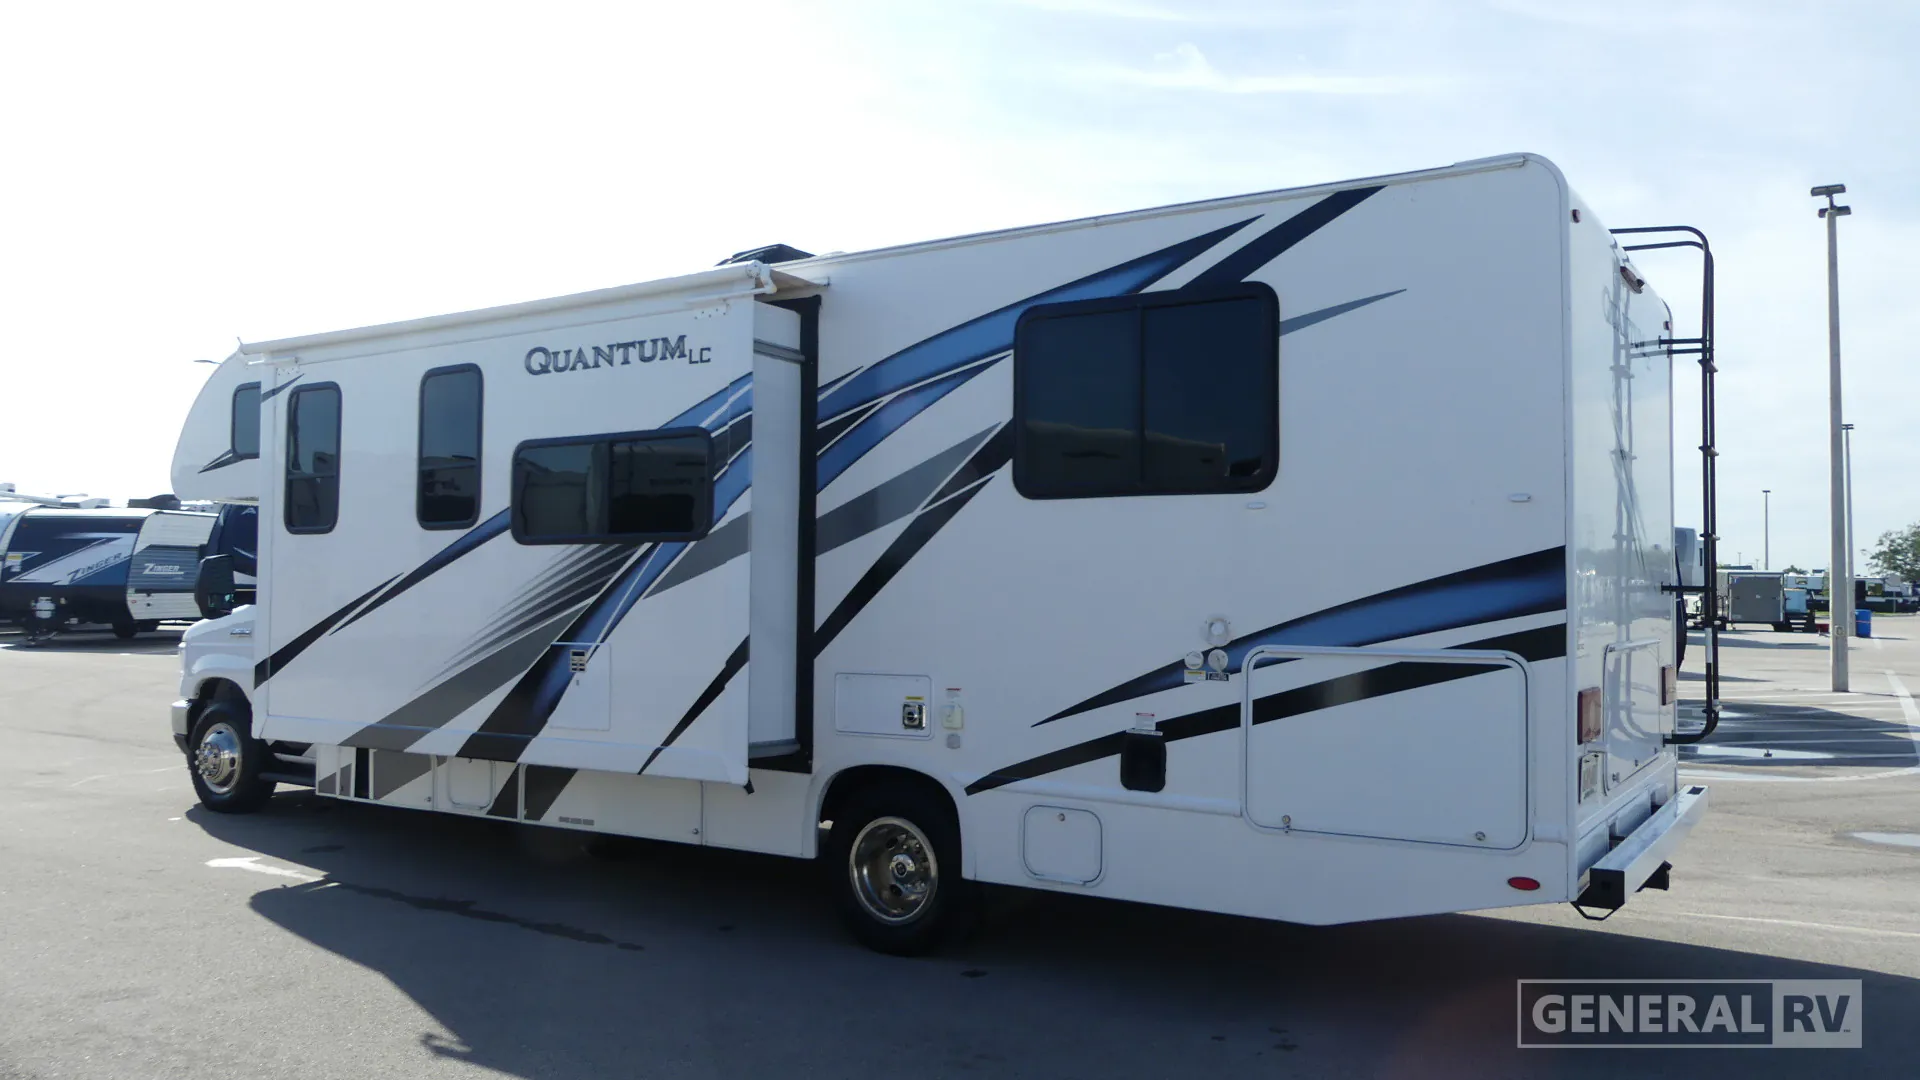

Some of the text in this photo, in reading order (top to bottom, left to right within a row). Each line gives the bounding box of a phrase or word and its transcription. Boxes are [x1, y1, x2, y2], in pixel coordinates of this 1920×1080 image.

[524, 335, 712, 376] QUANTUM LC
[67, 552, 122, 584] ZINGER
[143, 563, 182, 575] ZINGER
